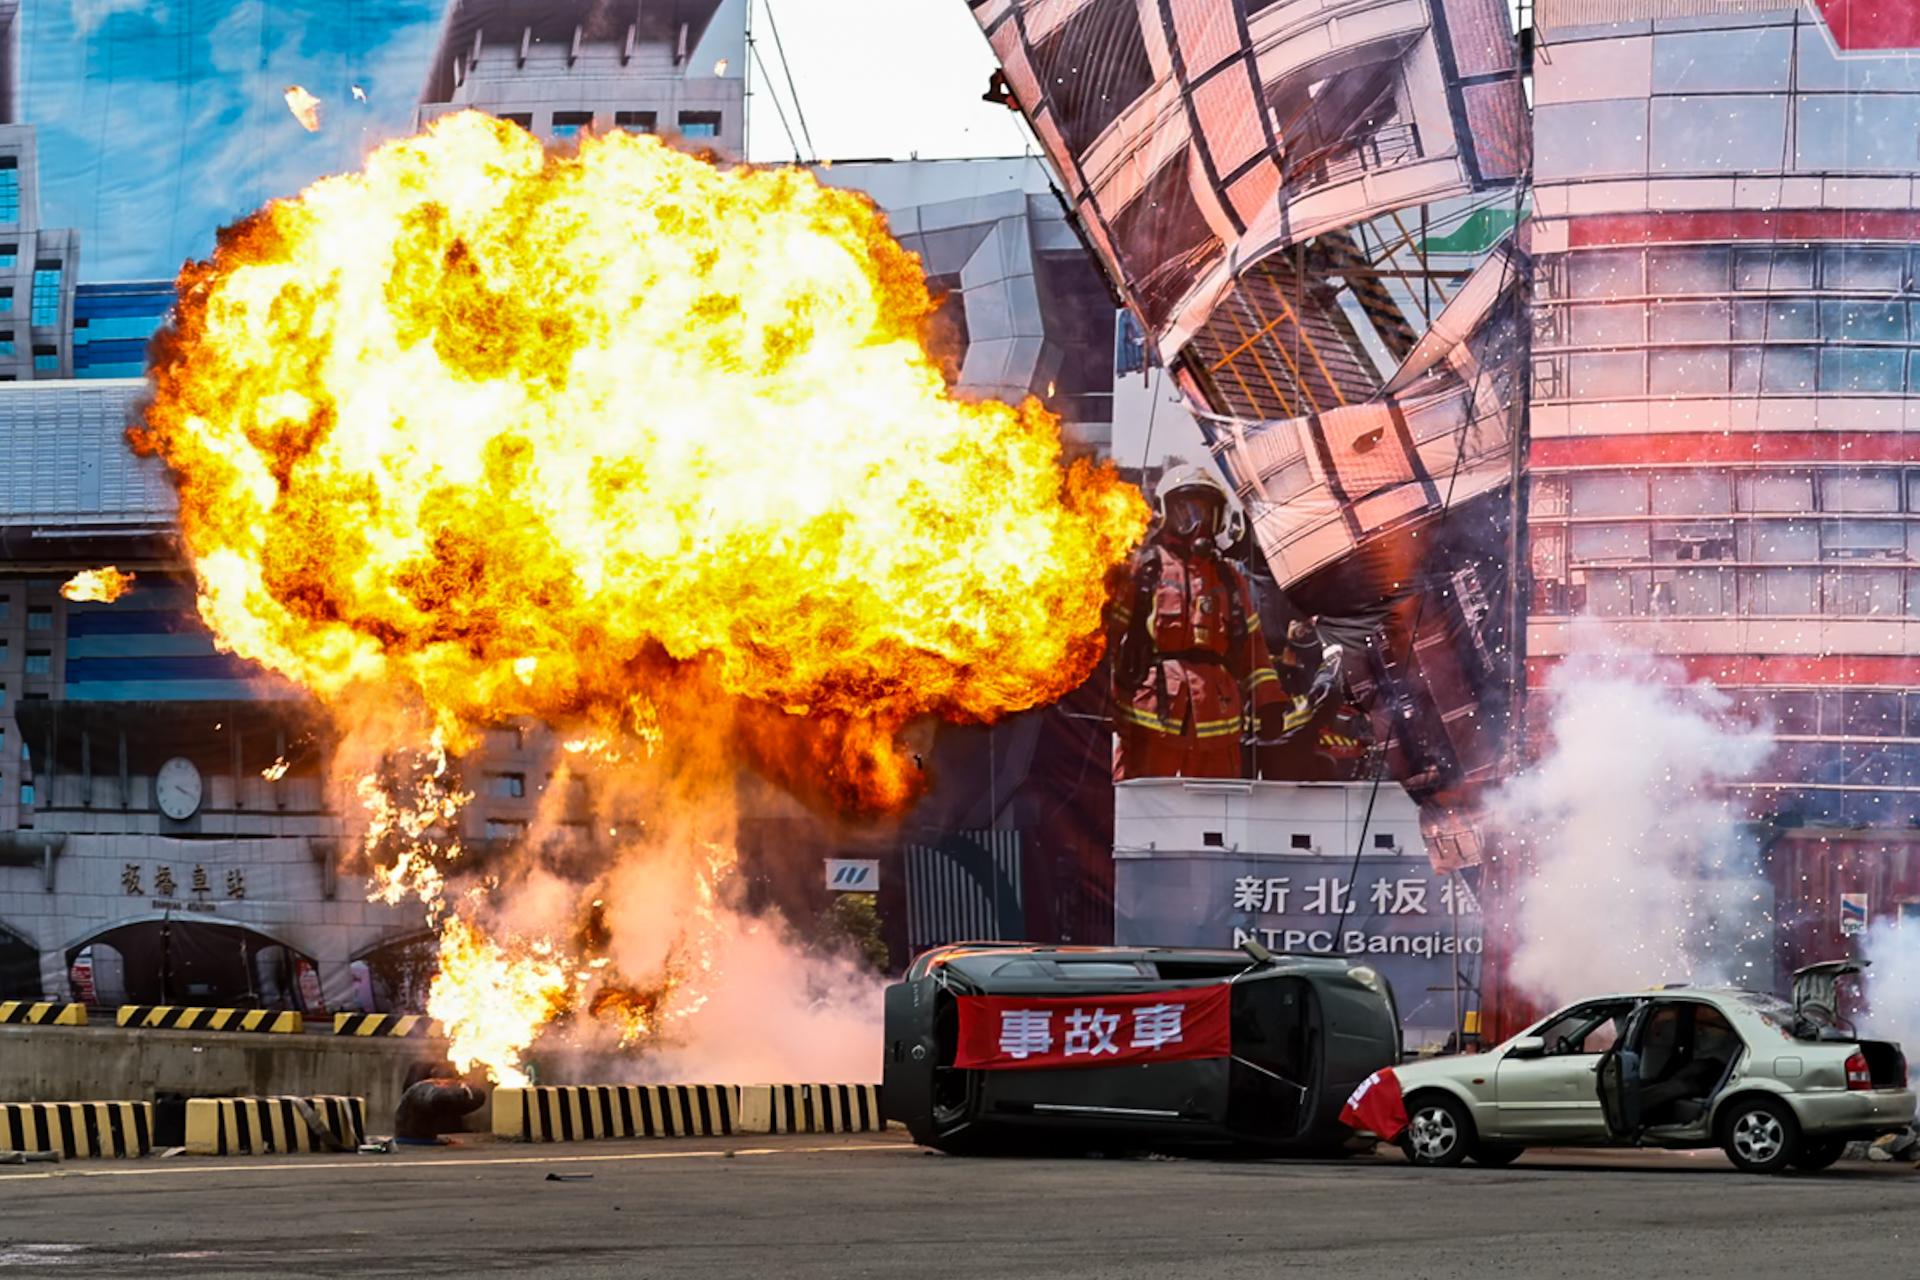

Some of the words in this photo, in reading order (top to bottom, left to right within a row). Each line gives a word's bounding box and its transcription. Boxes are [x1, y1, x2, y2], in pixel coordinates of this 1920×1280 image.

[1233, 926, 1333, 953] NTPC
[1344, 931, 1483, 958] Banqiao
[998, 1002, 1186, 1060] 事故車
